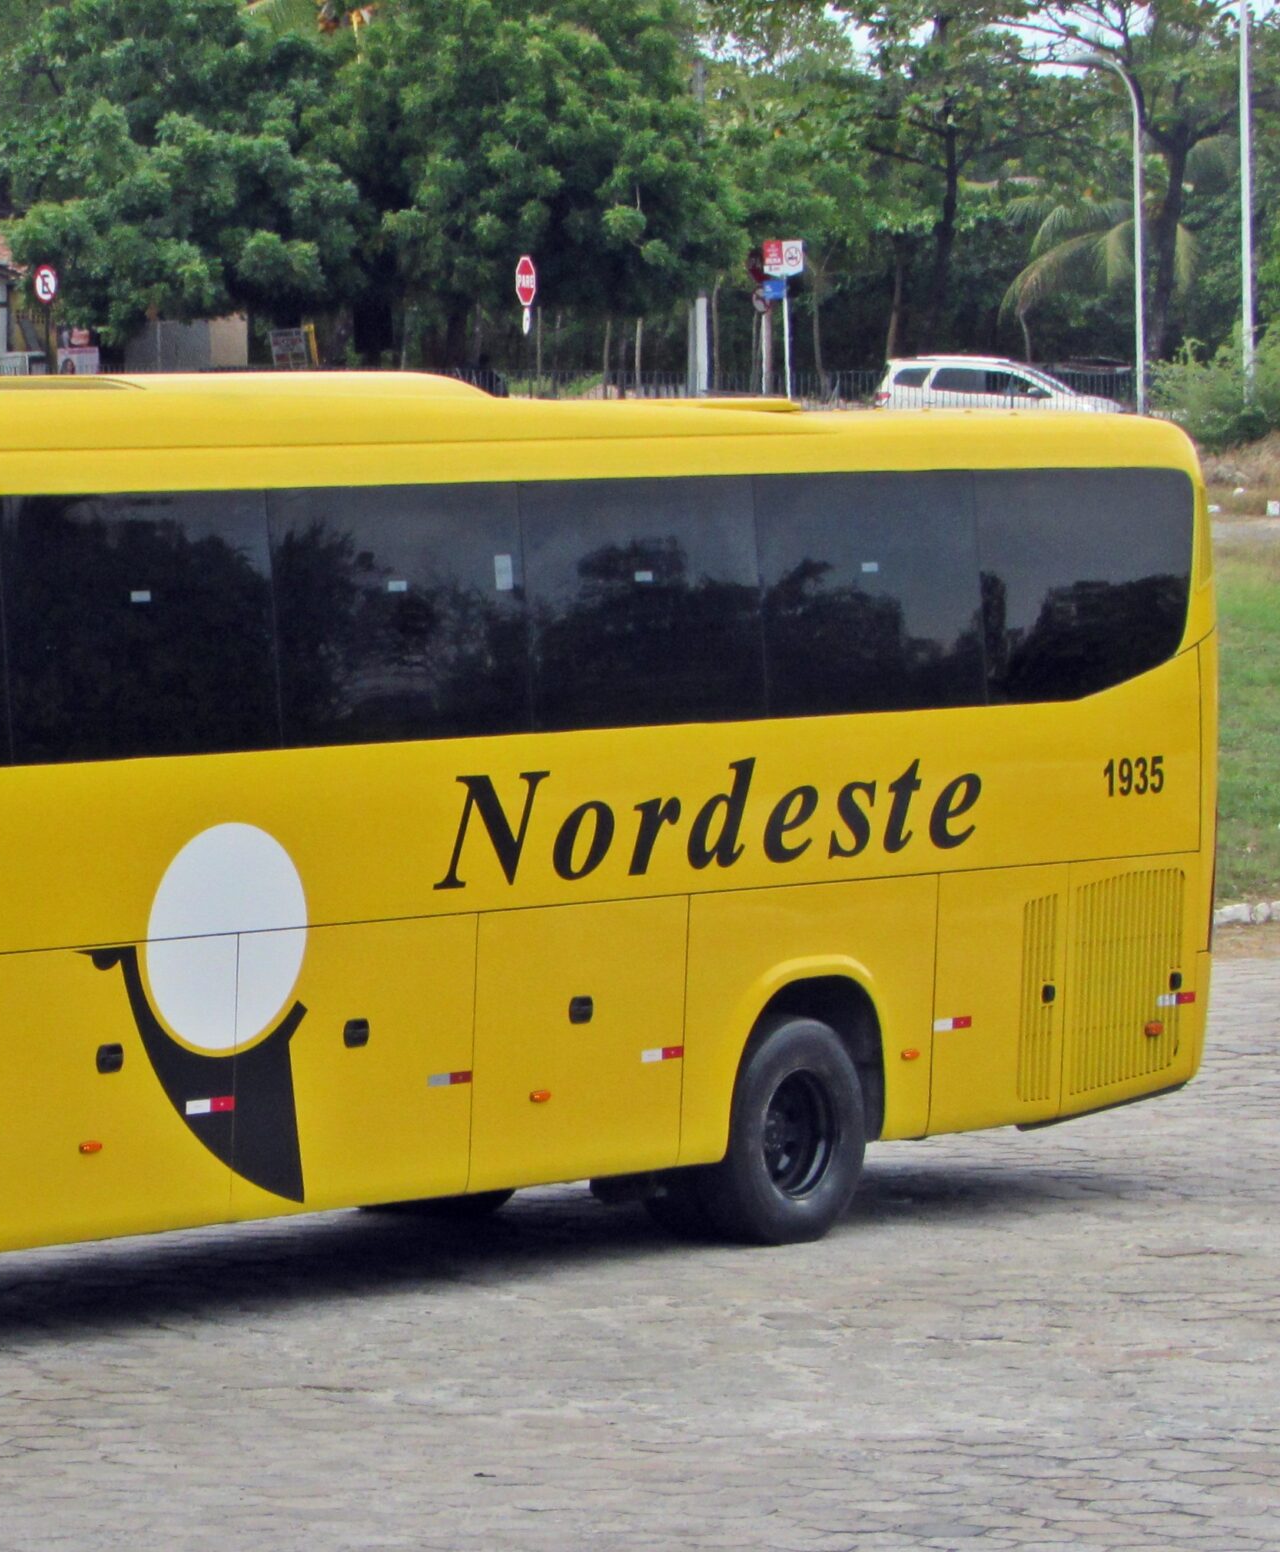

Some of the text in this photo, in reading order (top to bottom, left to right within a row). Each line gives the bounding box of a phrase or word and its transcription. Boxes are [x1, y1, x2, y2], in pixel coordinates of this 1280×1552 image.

[516, 274, 534, 289] PARE
[1103, 756, 1165, 798] 1935
[433, 757, 983, 889] Nordeste
